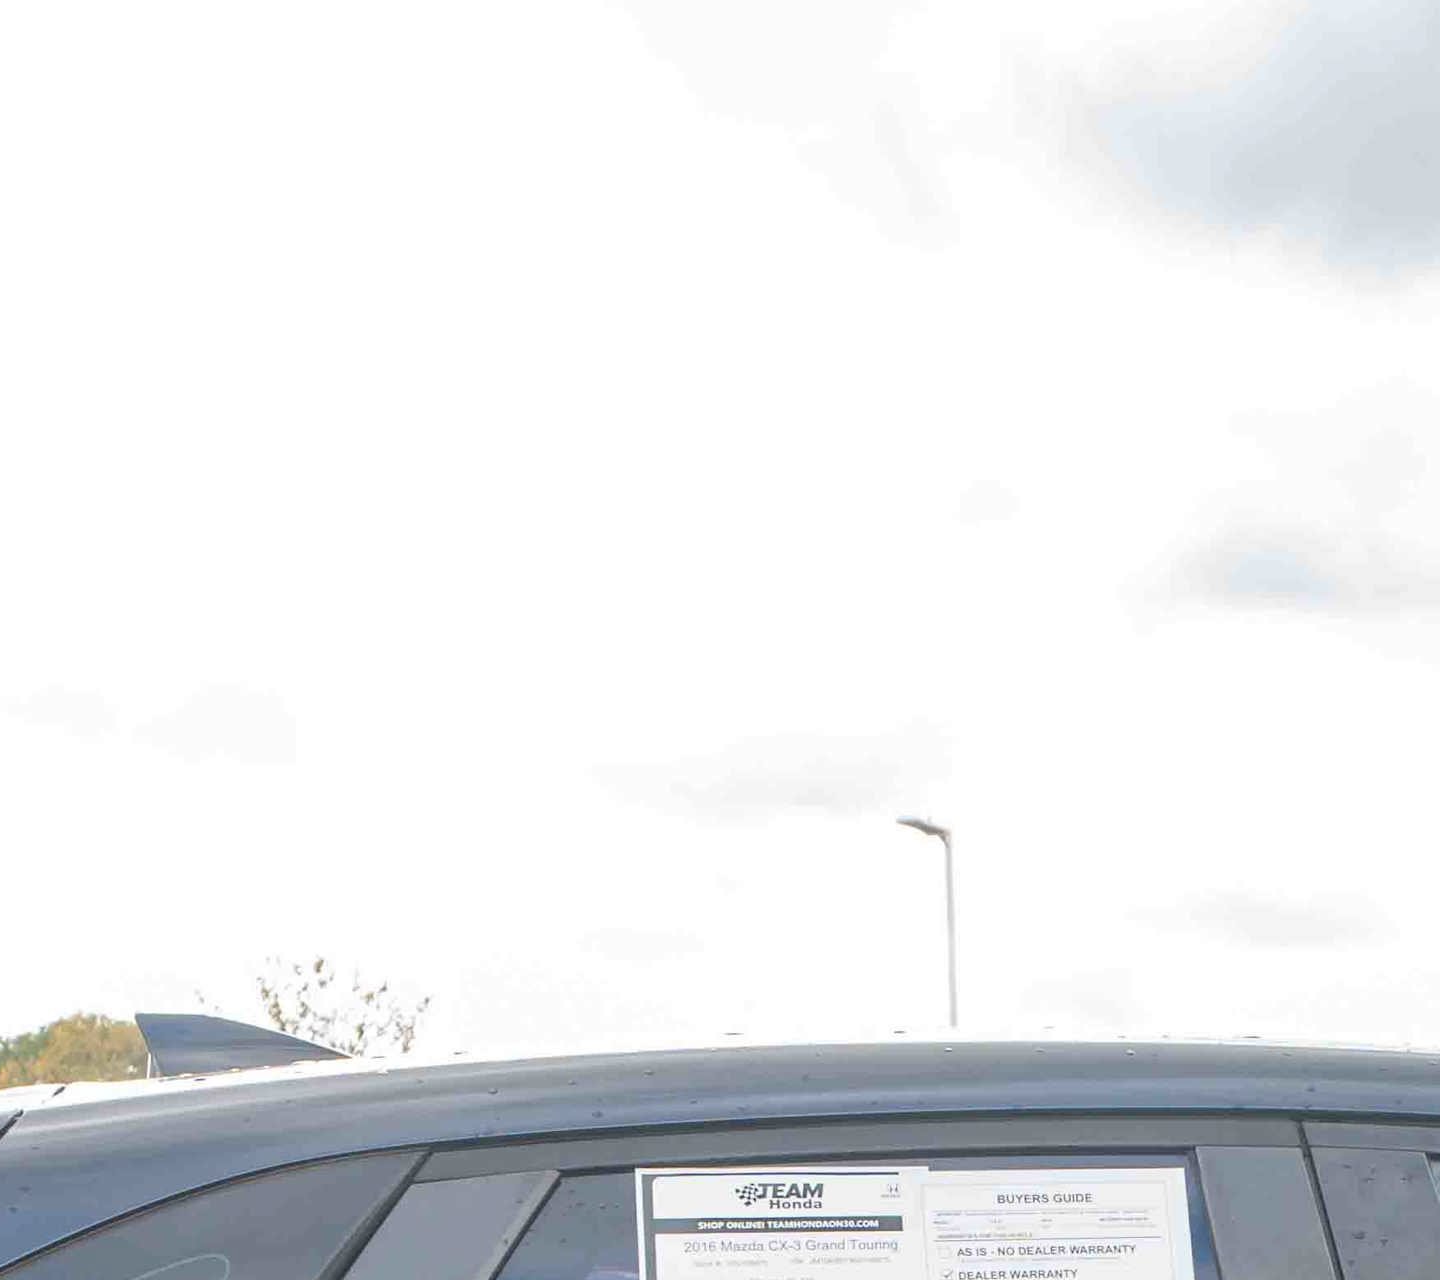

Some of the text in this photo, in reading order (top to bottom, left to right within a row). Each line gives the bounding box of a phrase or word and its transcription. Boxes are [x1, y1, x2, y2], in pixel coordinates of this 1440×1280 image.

[757, 1183, 824, 1199] TEAM
[997, 1193, 1094, 1204] BUYERS GUIDE
[769, 1199, 823, 1210] Honda
[697, 1220, 725, 1230] SHOP
[726, 1220, 766, 1230] ONLINE!
[684, 1238, 899, 1253] 2016 Mazda CX-3 Grand Touring
[957, 1247, 973, 1257] AS
[975, 1247, 988, 1257] IS
[997, 1247, 1016, 1256] NO
[1018, 1245, 1066, 1255] DEALER
[1069, 1244, 1137, 1255] WARRANTY
[958, 1269, 1078, 1280] DEALER WARRANTY
